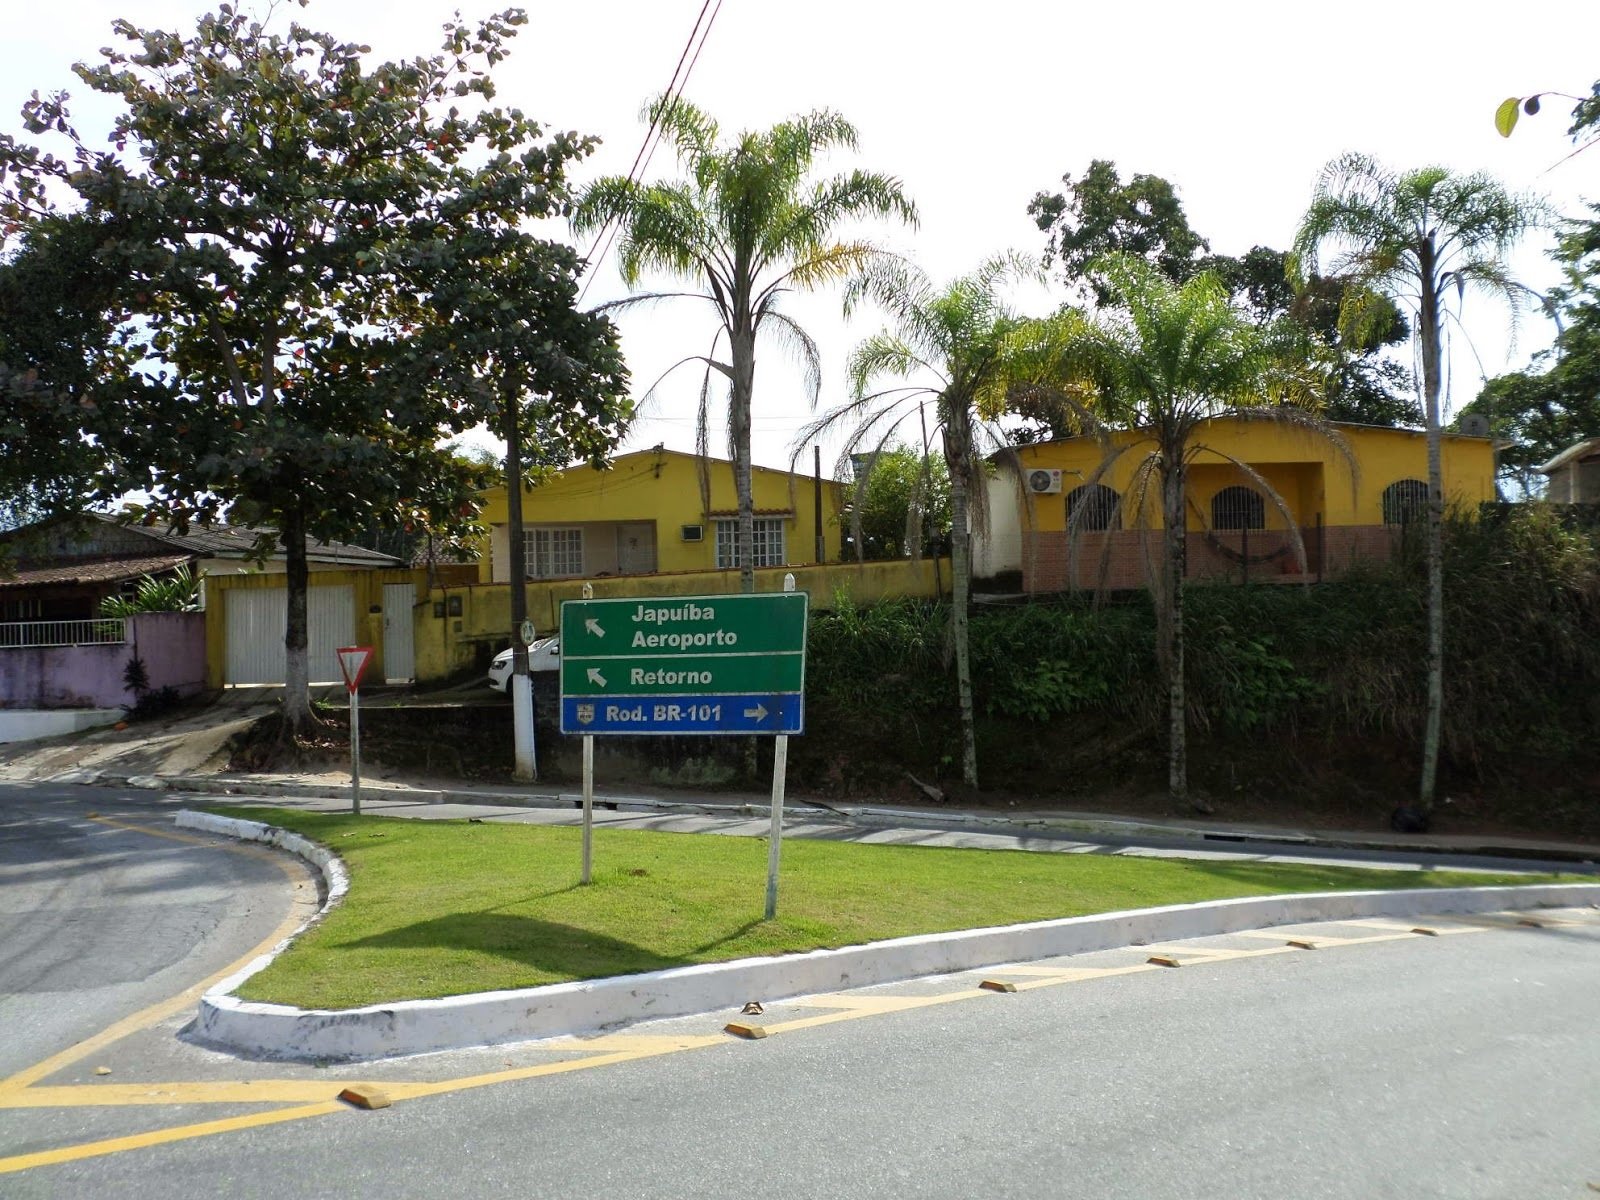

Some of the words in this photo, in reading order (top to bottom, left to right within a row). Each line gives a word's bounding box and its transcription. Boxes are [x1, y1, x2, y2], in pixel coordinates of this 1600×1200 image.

[631, 603, 715, 625] Japuíba
[631, 629, 738, 650] Aeroporto
[630, 668, 713, 685] Retorno
[606, 705, 648, 722] Rod.
[653, 705, 722, 722] BR-101
